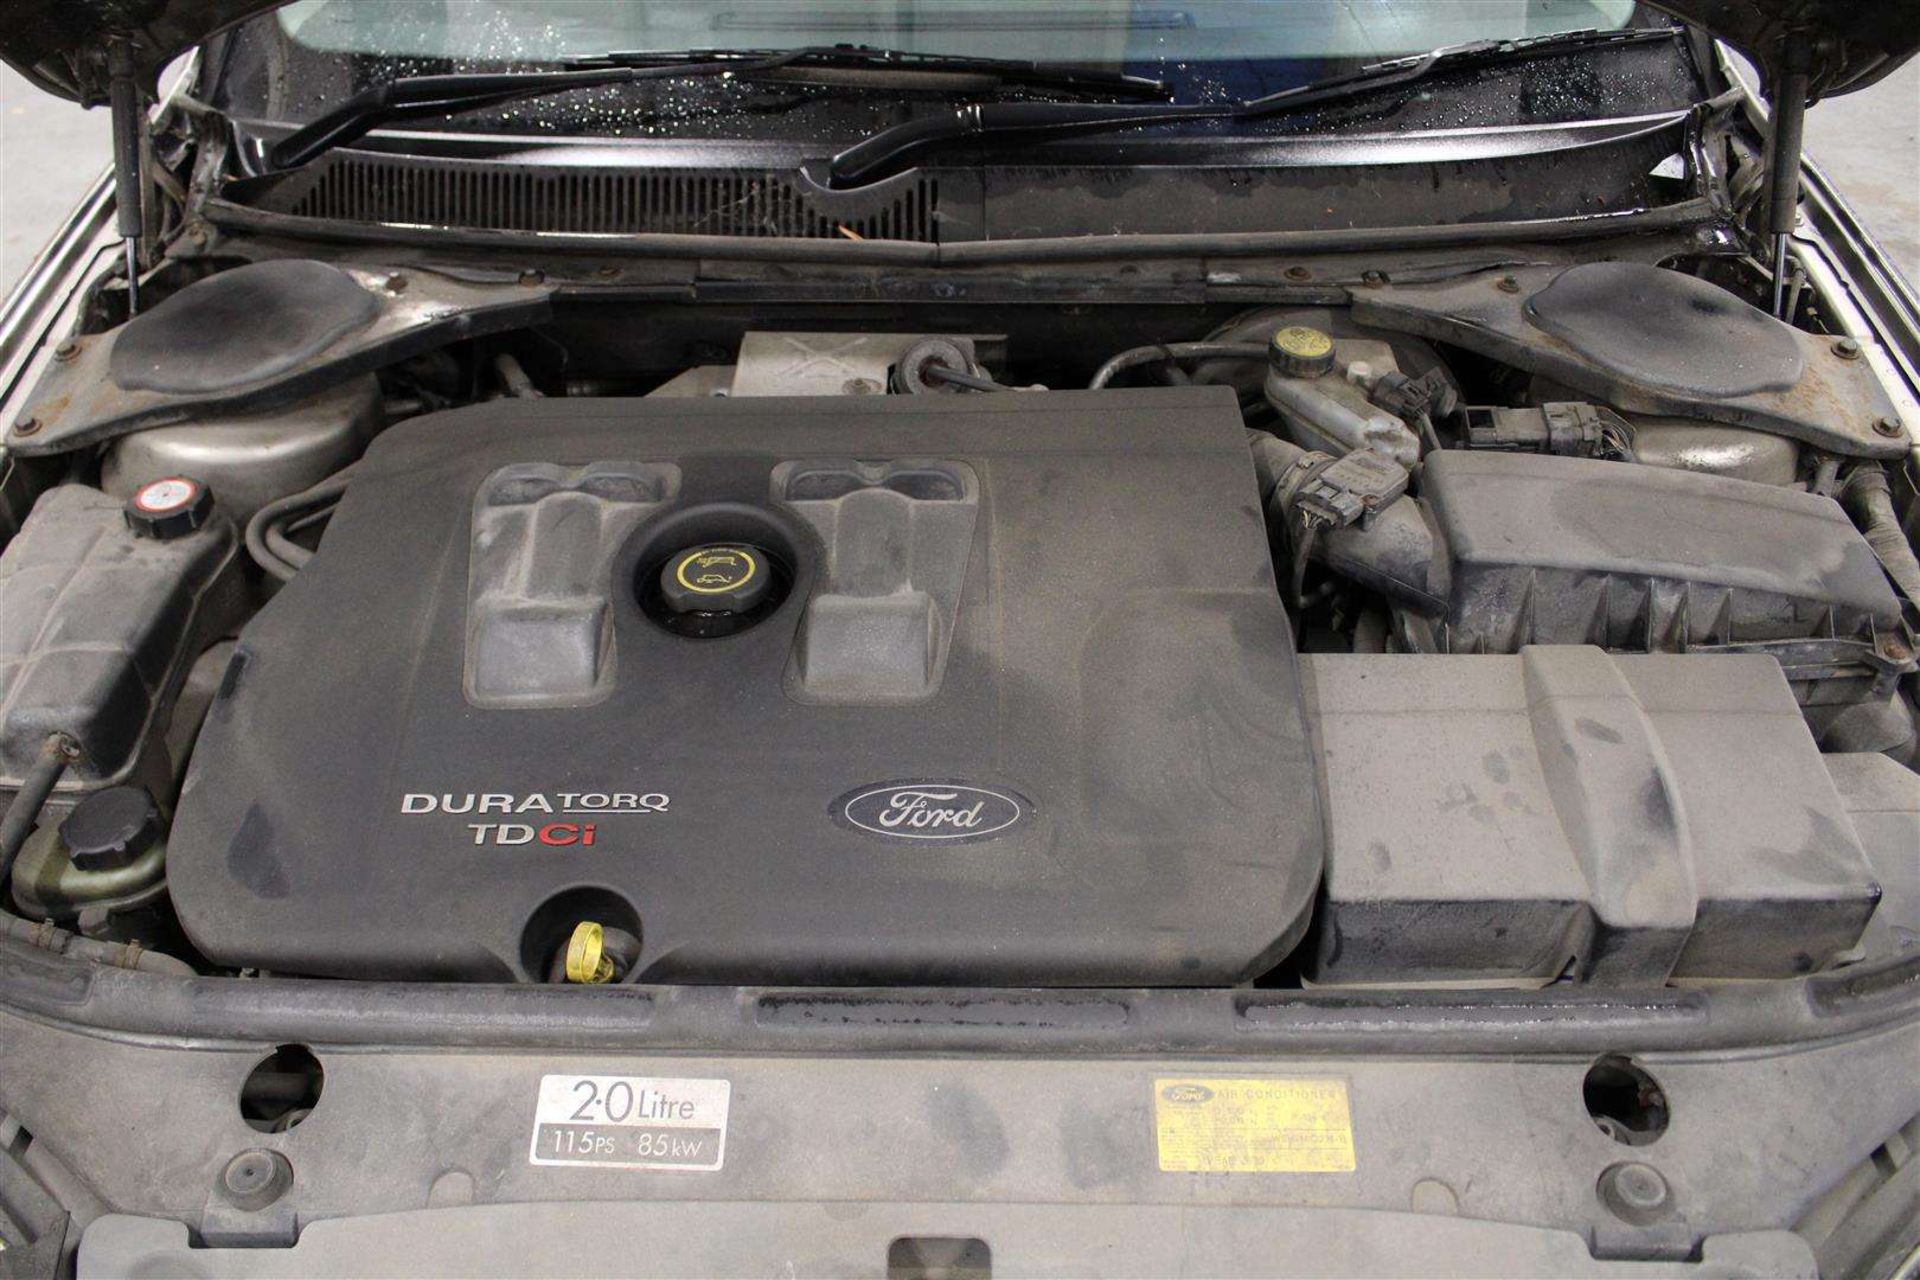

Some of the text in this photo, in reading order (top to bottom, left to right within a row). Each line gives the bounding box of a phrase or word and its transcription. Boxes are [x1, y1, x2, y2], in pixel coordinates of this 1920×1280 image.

[400, 793, 671, 814] DURATORQ
[878, 791, 985, 828] Ford
[467, 823, 597, 846] TDCi
[1170, 1087, 1206, 1101] Ford
[1216, 1087, 1238, 1099] AIR
[638, 1089, 696, 1120] Litre
